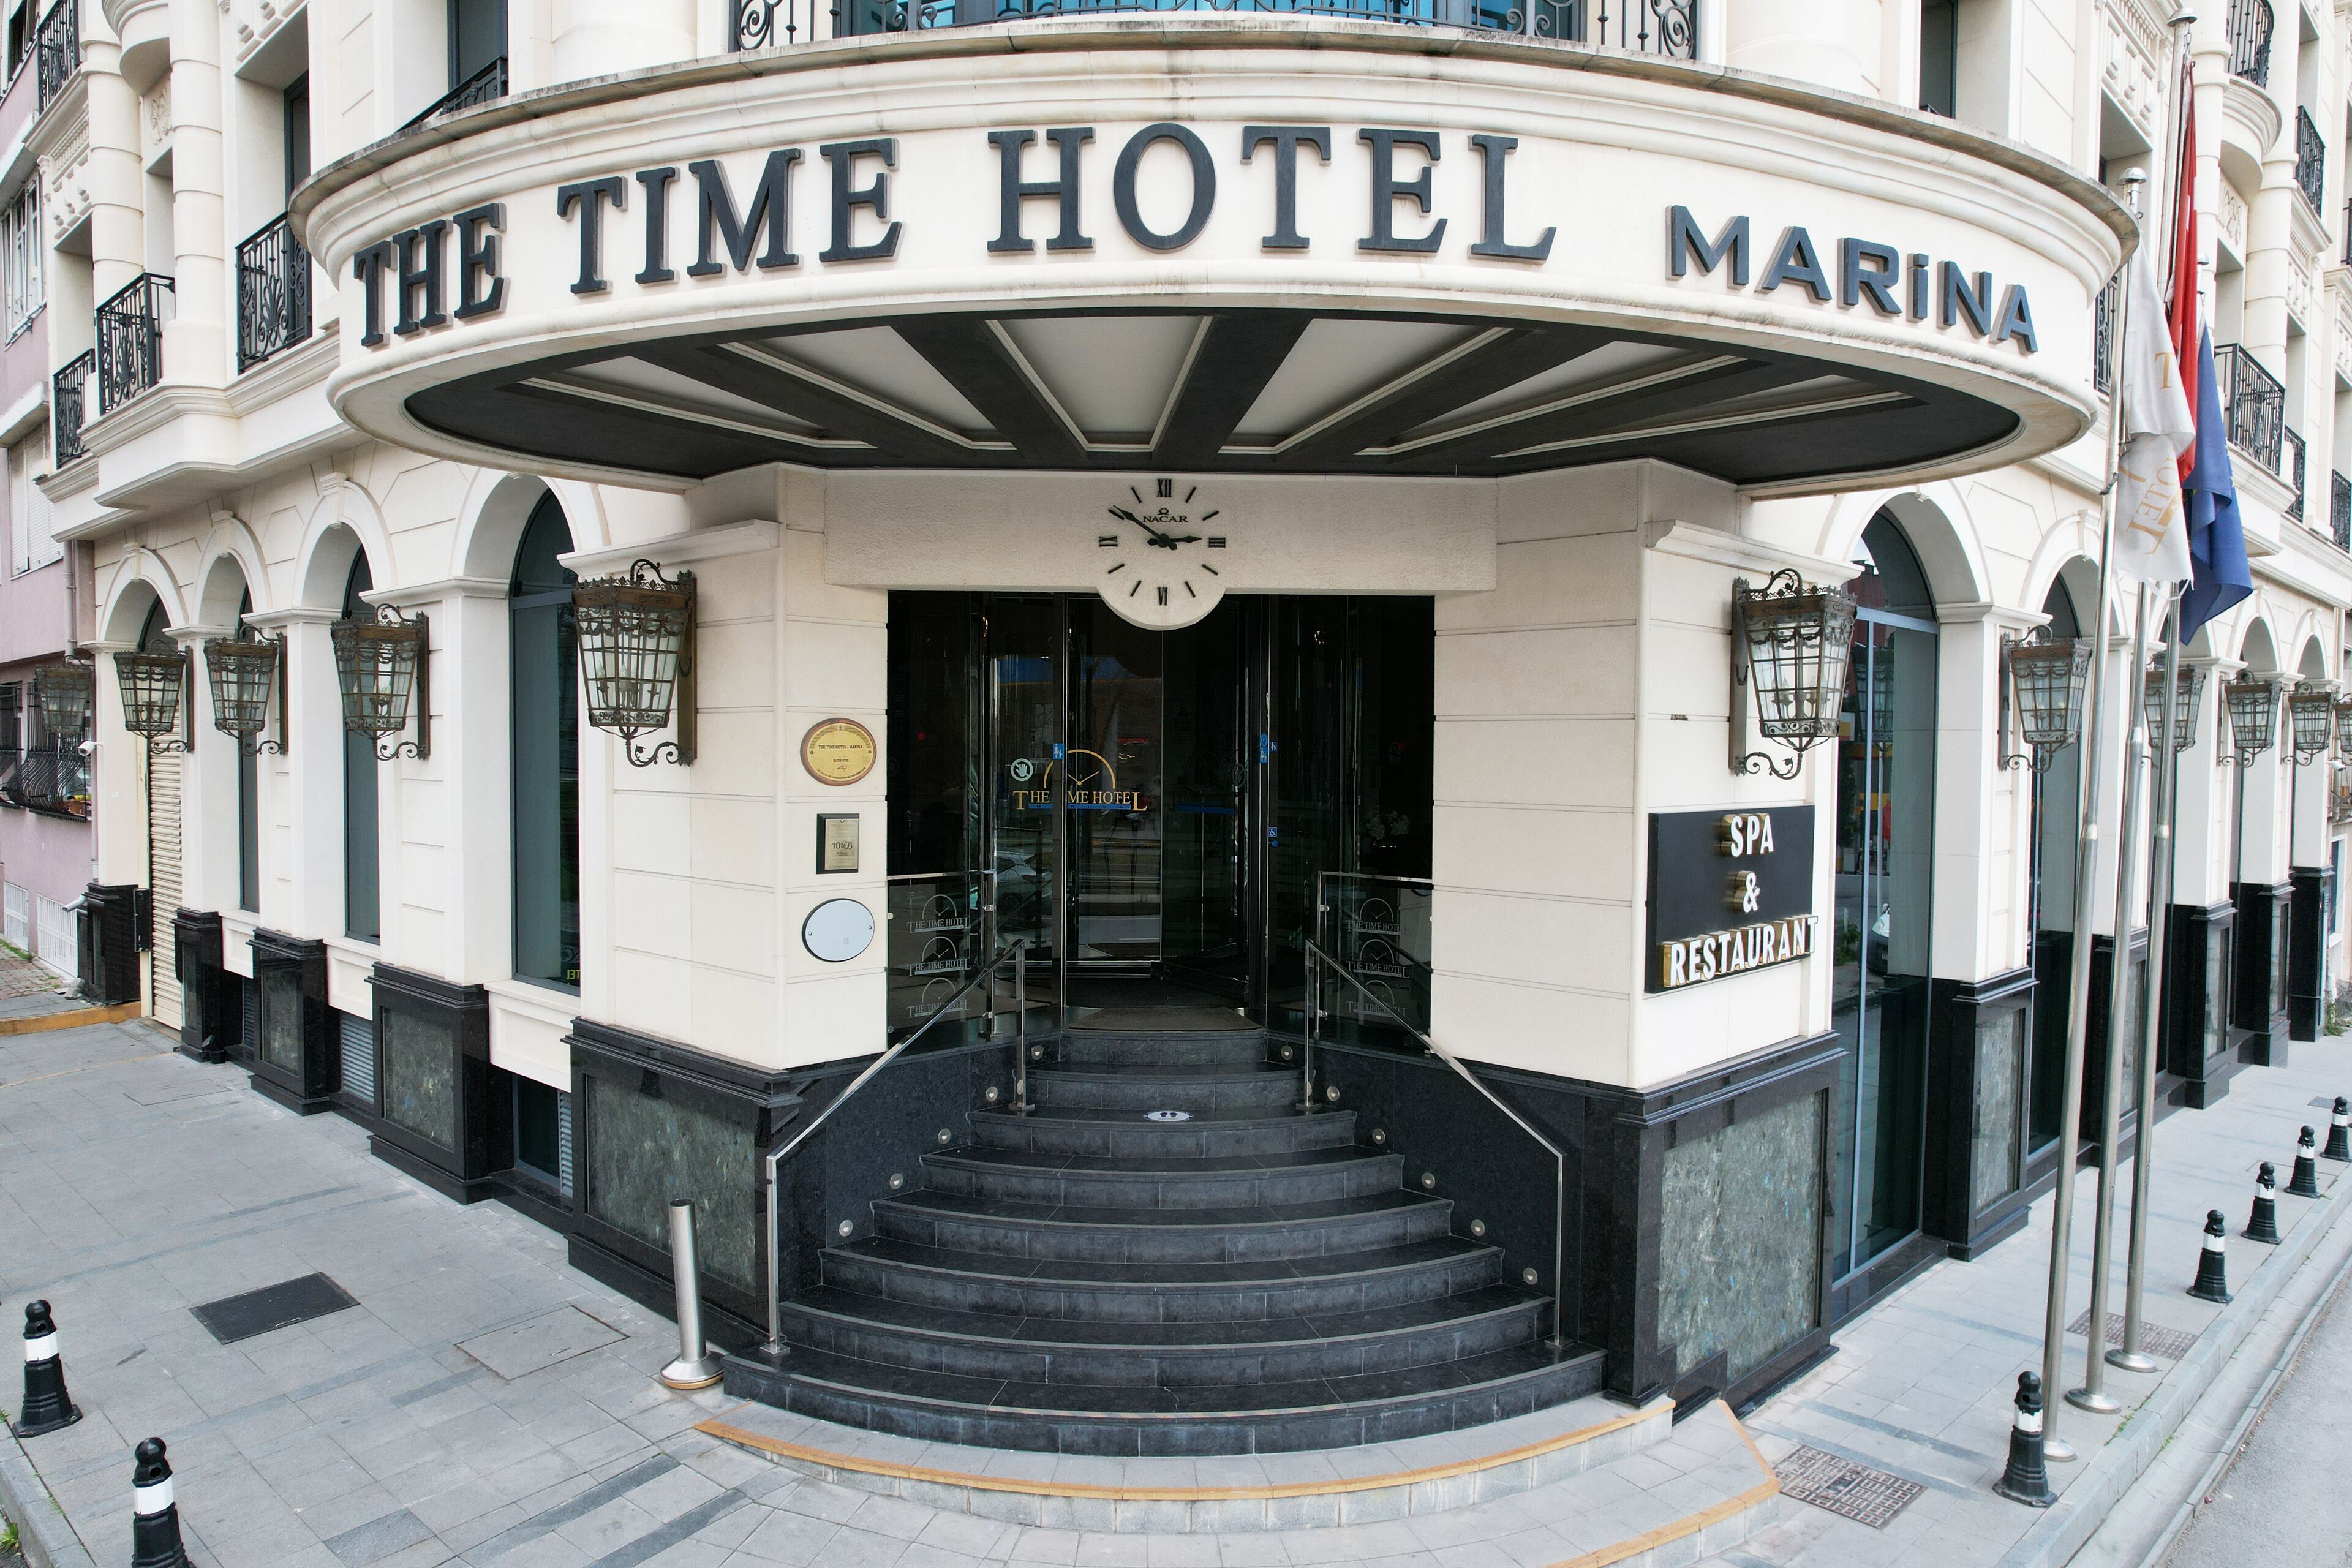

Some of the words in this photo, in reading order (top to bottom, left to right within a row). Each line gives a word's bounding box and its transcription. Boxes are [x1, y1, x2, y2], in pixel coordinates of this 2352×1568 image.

[353, 202, 507, 347] THE
[557, 137, 904, 295] TIME
[987, 123, 1556, 265] HOTEL
[1157, 478, 1172, 497] XII
[2125, 456, 2178, 555] OTEL
[1157, 587, 1168, 605] VI
[1012, 790, 1049, 810] THE
[1067, 791, 1088, 804] ME
[1093, 791, 1148, 811] HOTEL
[1725, 814, 1774, 858] SPA
[1741, 870, 1760, 914] &
[907, 921, 925, 933] THE
[927, 919, 944, 928] TIME
[946, 916, 971, 929] HOTEL
[1364, 921, 1382, 930] TIME
[1665, 916, 1819, 987] RESTAURANT
[907, 963, 925, 976] THE
[927, 961, 944, 970] TIME
[946, 958, 971, 970] HOTEL
[1346, 960, 1363, 971] THE
[1365, 962, 1382, 971] TIME
[1383, 964, 1409, 979] HOTEL
[907, 1005, 925, 1019] THE
[1365, 1003, 1382, 1013] TIME
